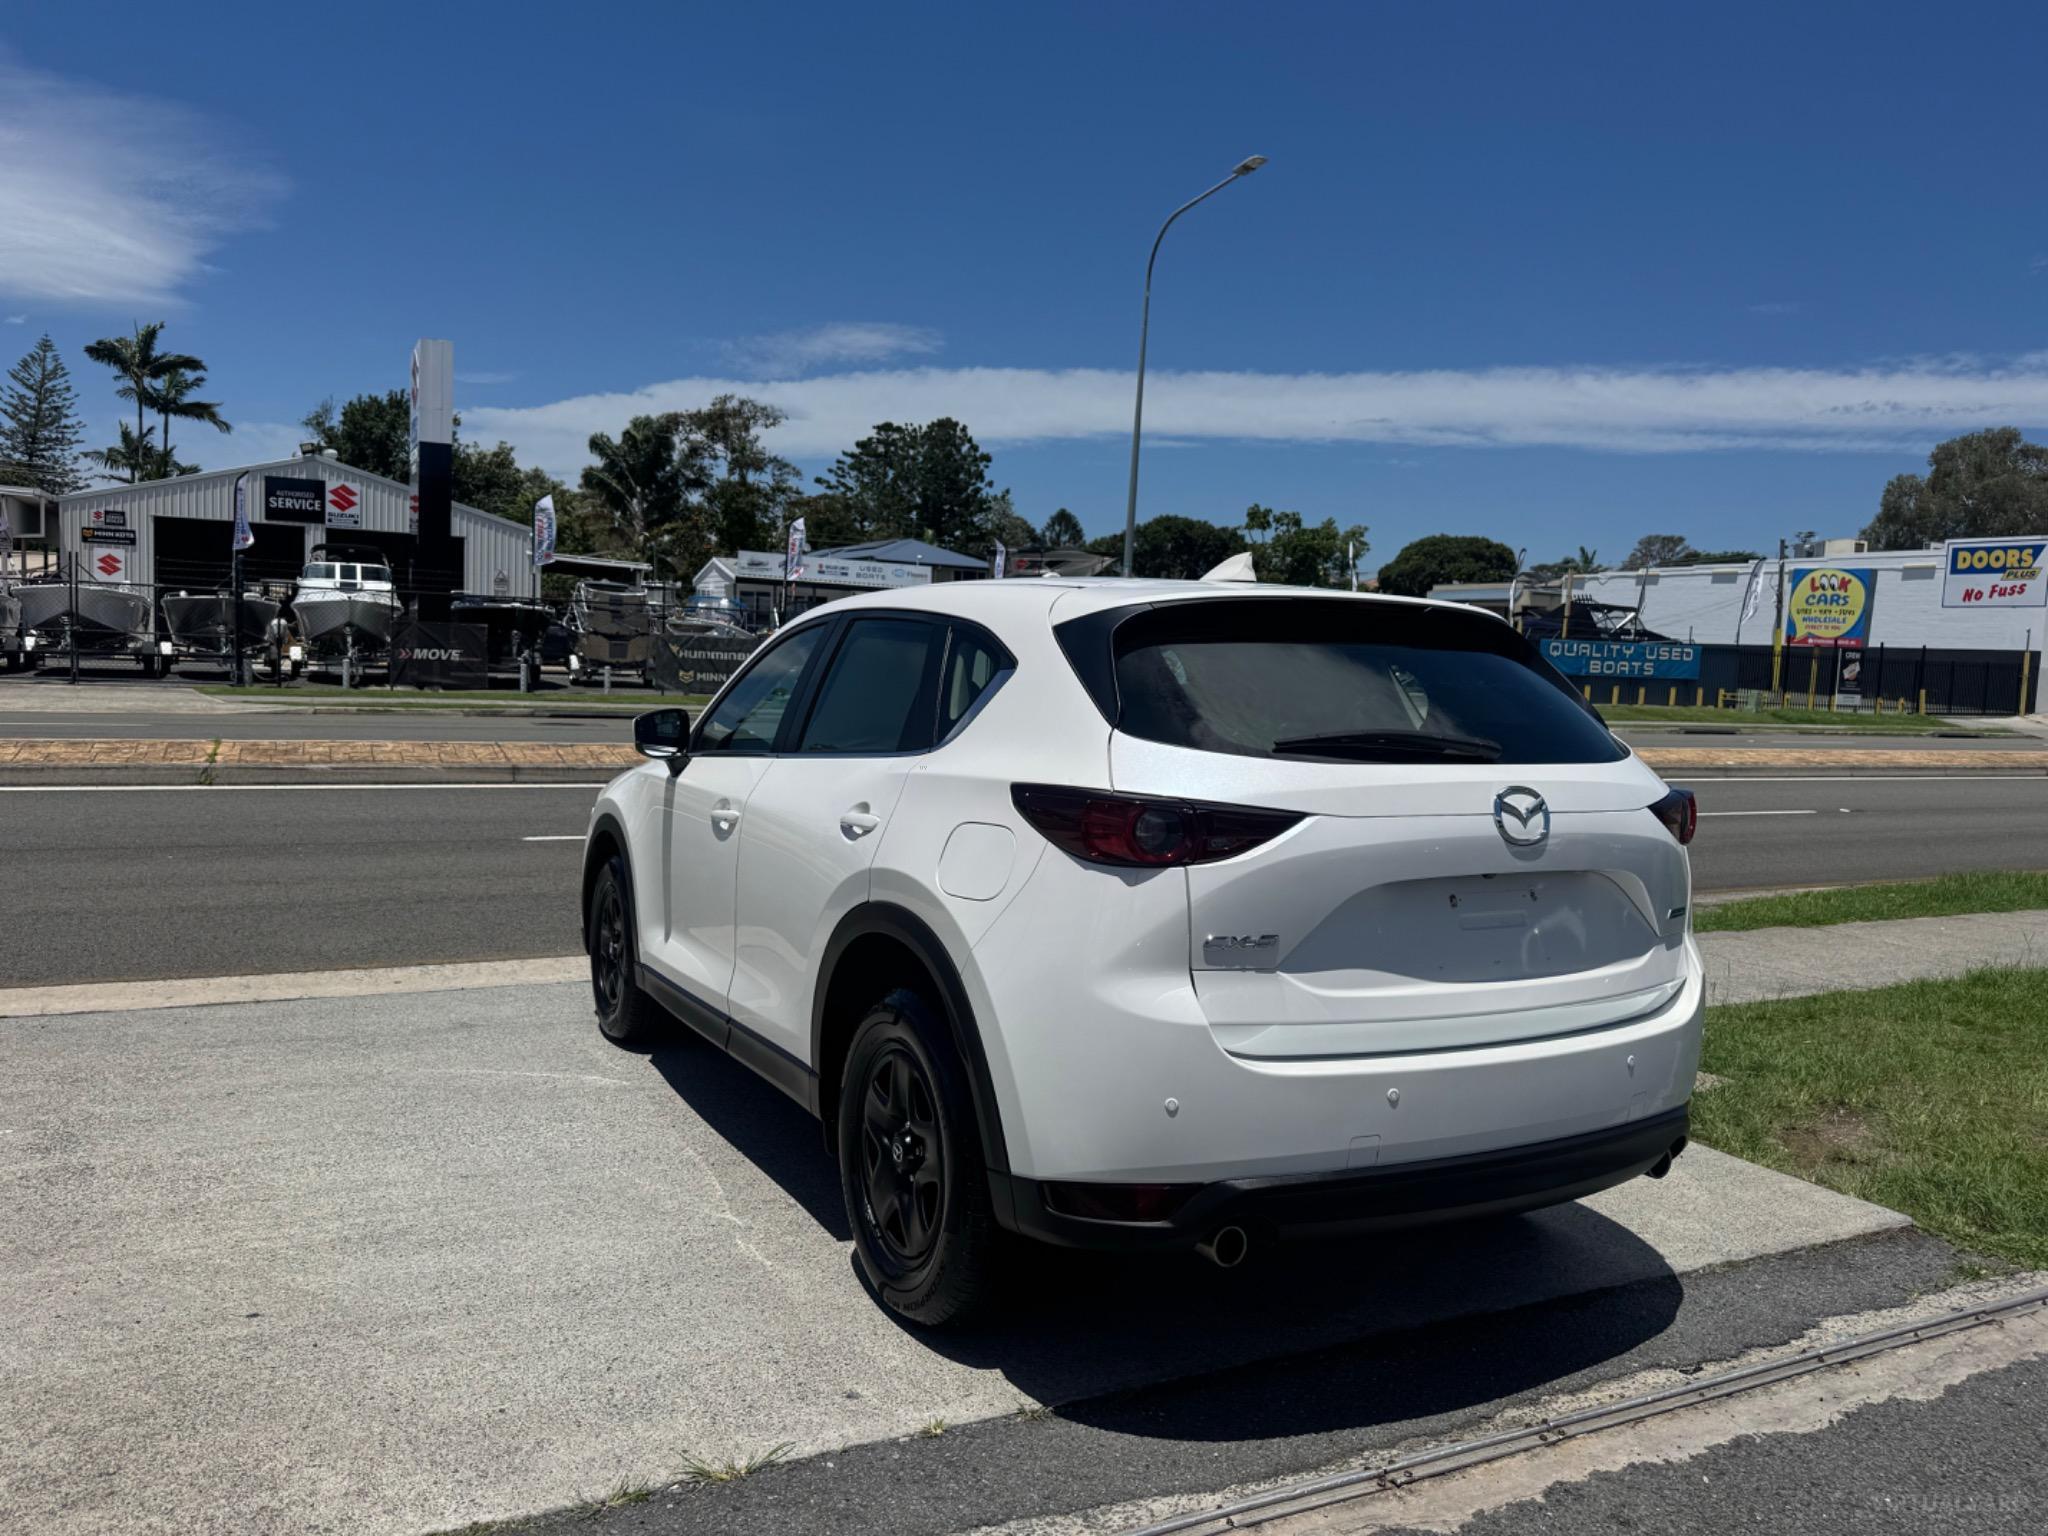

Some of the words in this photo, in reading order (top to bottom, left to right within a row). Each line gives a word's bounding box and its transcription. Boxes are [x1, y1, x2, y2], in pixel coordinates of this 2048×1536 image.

[268, 496, 322, 511] SERVICE
[328, 511, 359, 519] SUZUKI
[1957, 548, 2034, 570] DOORS
[2006, 570, 2037, 579] PLUS
[1810, 573, 1852, 593] LOOK
[1805, 592, 1850, 606] CARS
[1963, 587, 1984, 603] No
[412, 647, 462, 662] MOVE
[1549, 641, 1635, 659] QUALITY
[1645, 646, 1694, 662] USED
[1589, 659, 1655, 676] BOATS
[696, 671, 727, 683] MINN
[1203, 934, 1280, 951] CX-5
